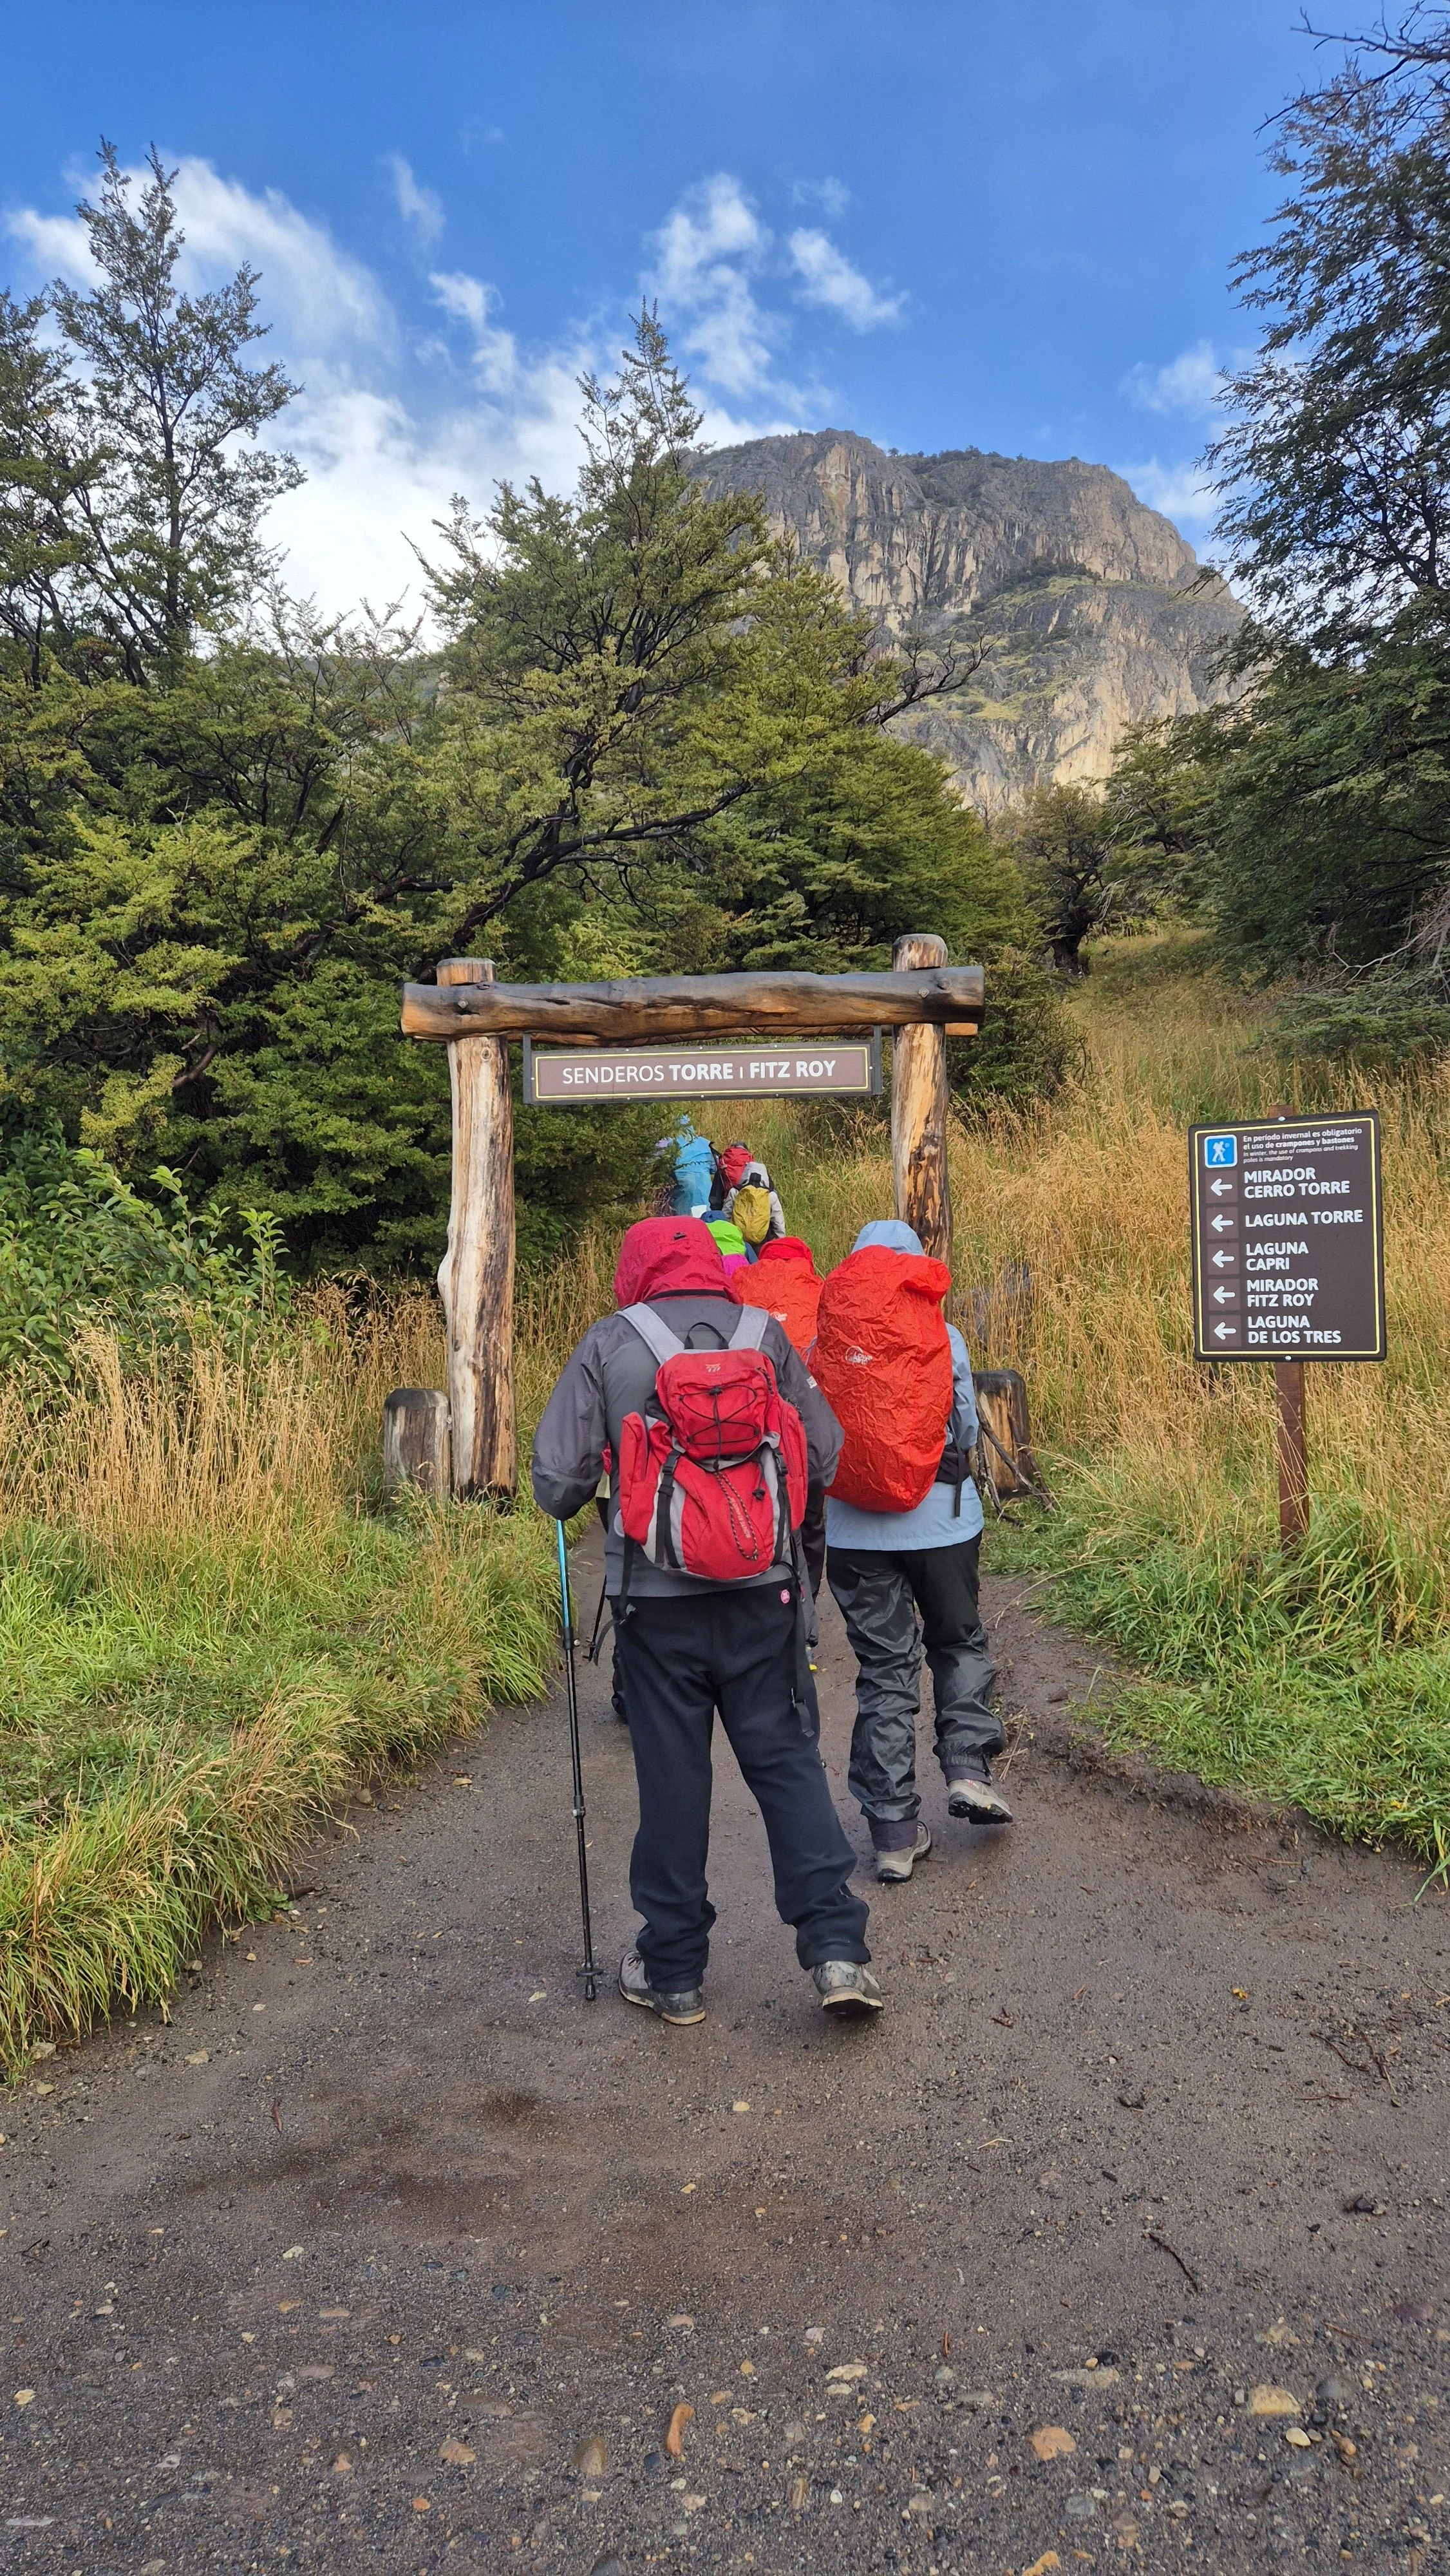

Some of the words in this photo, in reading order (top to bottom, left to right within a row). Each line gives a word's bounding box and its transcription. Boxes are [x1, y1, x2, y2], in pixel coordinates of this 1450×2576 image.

[562, 1065, 664, 1085] SENDEROS
[669, 1062, 733, 1081] TORRE
[749, 1061, 791, 1079] FITZ
[796, 1060, 836, 1077] ROY
[1282, 1130, 1311, 1140] invernal
[1321, 1127, 1362, 1137] obligatorio
[1276, 1140, 1315, 1148] crampones
[1244, 1167, 1316, 1184] MIRADOR
[1244, 1182, 1295, 1198] CERRO
[1300, 1180, 1350, 1196] TORRE
[1245, 1213, 1308, 1227] LAGUNA
[1311, 1209, 1364, 1225] TORRE
[1246, 1242, 1309, 1256] LAGUNA
[1246, 1258, 1290, 1271] CAPRI
[1247, 1278, 1319, 1293] MIRADOR
[1247, 1294, 1279, 1307] FITZ
[1283, 1293, 1314, 1307] ROY
[1248, 1315, 1310, 1329] LAGUNA
[1248, 1331, 1268, 1344] DE
[1272, 1331, 1301, 1344] LOS
[1303, 1330, 1342, 1343] TRES
